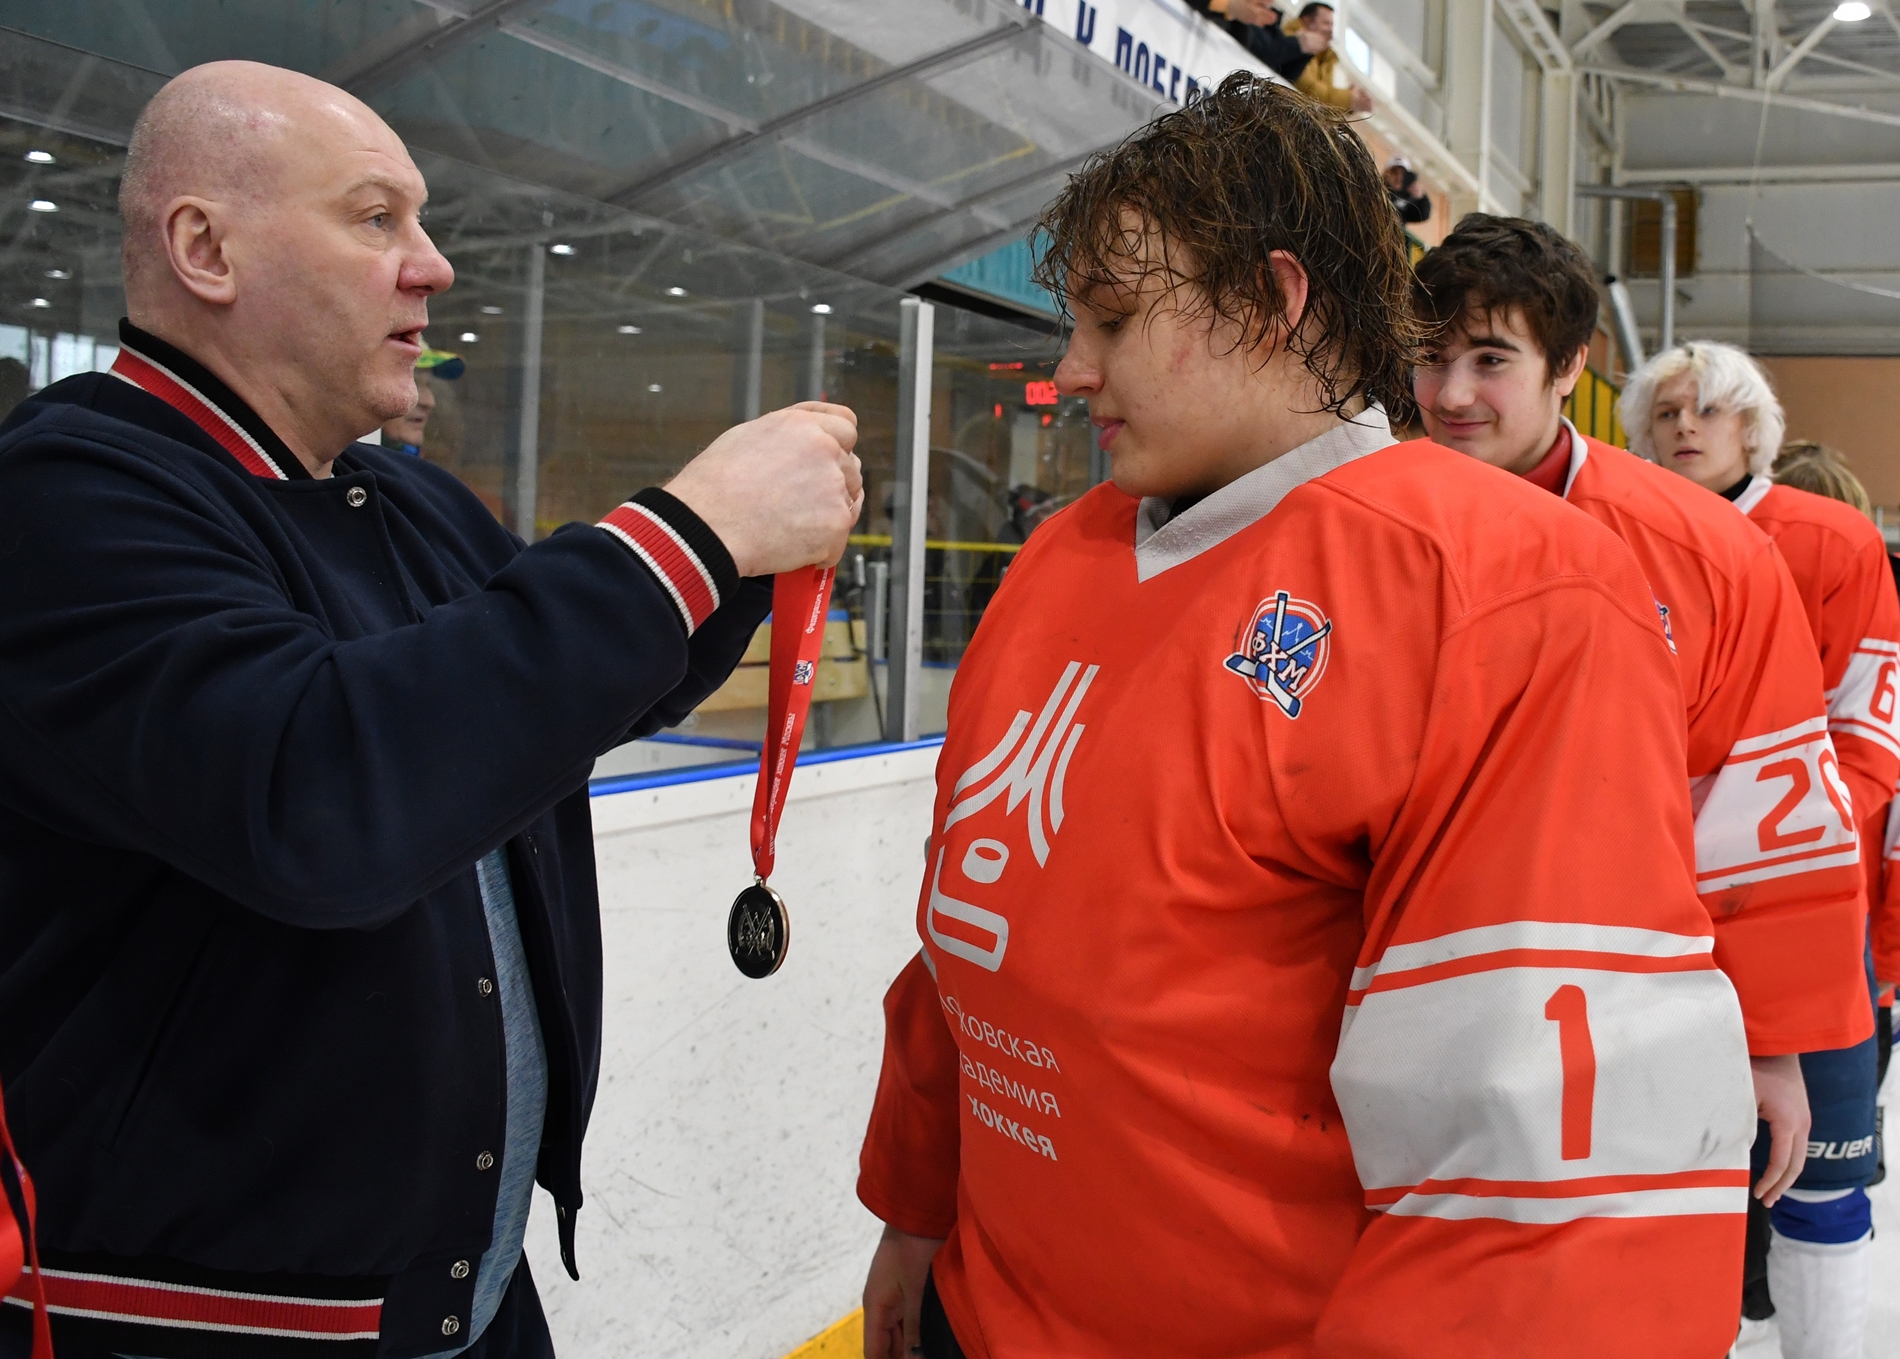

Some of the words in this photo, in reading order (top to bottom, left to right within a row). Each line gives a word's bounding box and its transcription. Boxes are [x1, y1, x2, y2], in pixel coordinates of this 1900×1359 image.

[1115, 26, 1211, 106] ПОБЕ
[960, 1051, 1061, 1118] адемия
[1544, 983, 1597, 1161] 1
[966, 1093, 1058, 1161] хоккея
